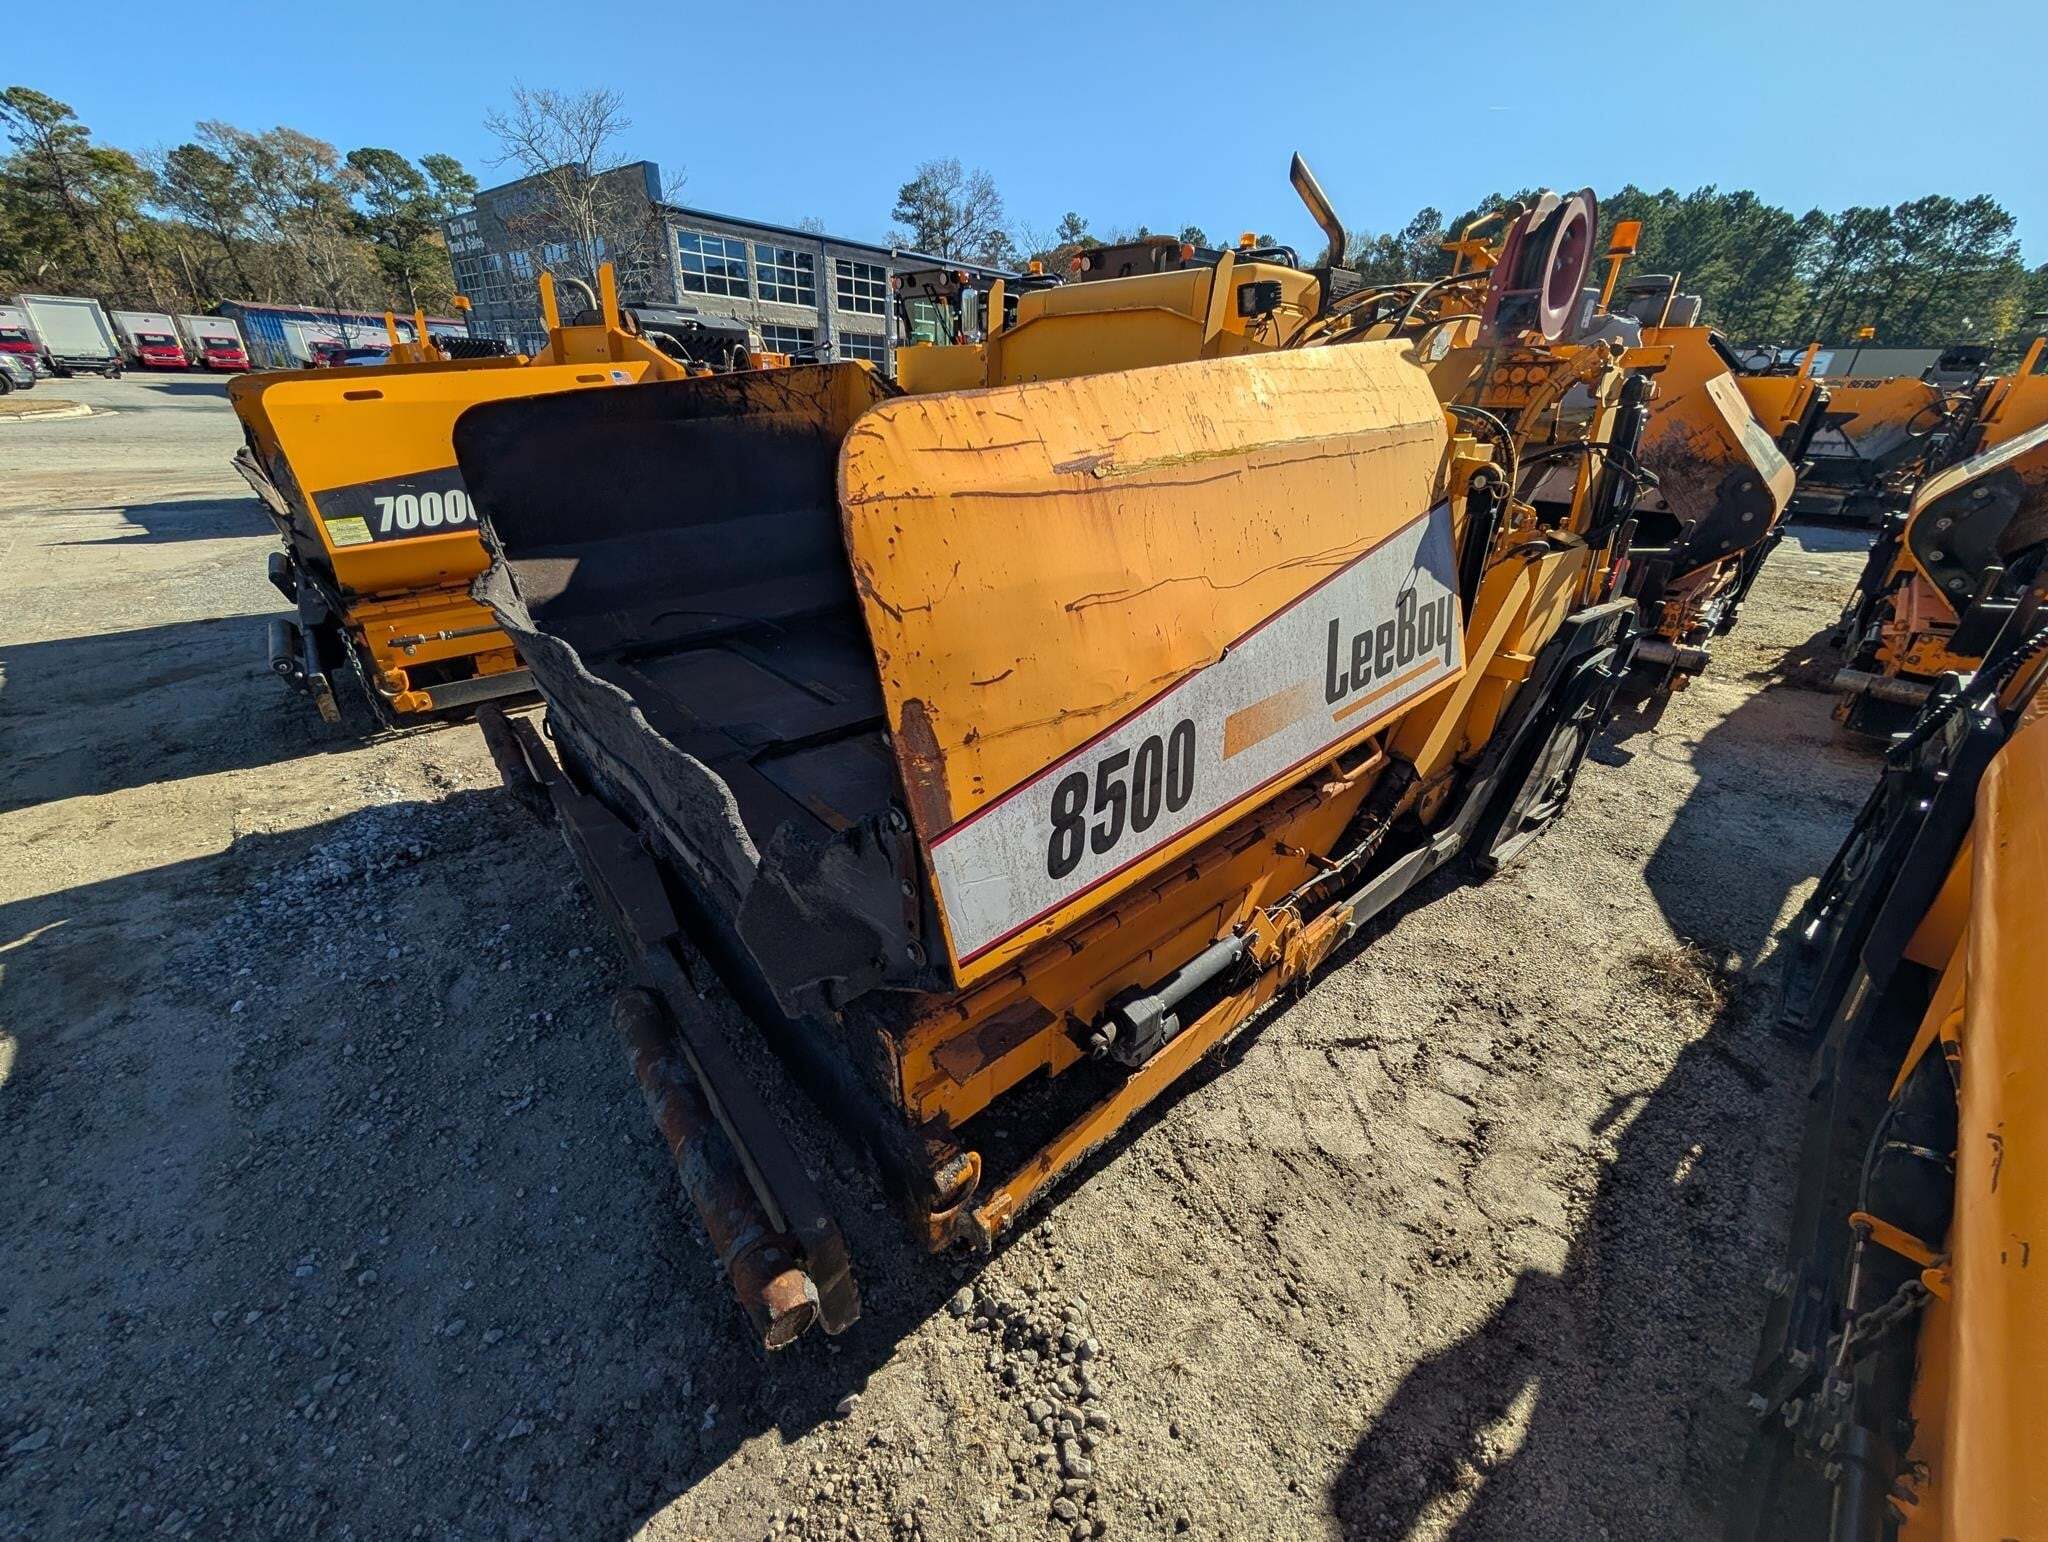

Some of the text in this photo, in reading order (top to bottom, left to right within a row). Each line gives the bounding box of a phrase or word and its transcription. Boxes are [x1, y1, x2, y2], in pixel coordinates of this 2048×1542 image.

[465, 235, 485, 250] Sales
[1325, 586, 1454, 706] LeeBoy
[1047, 718, 1196, 880] 8500
